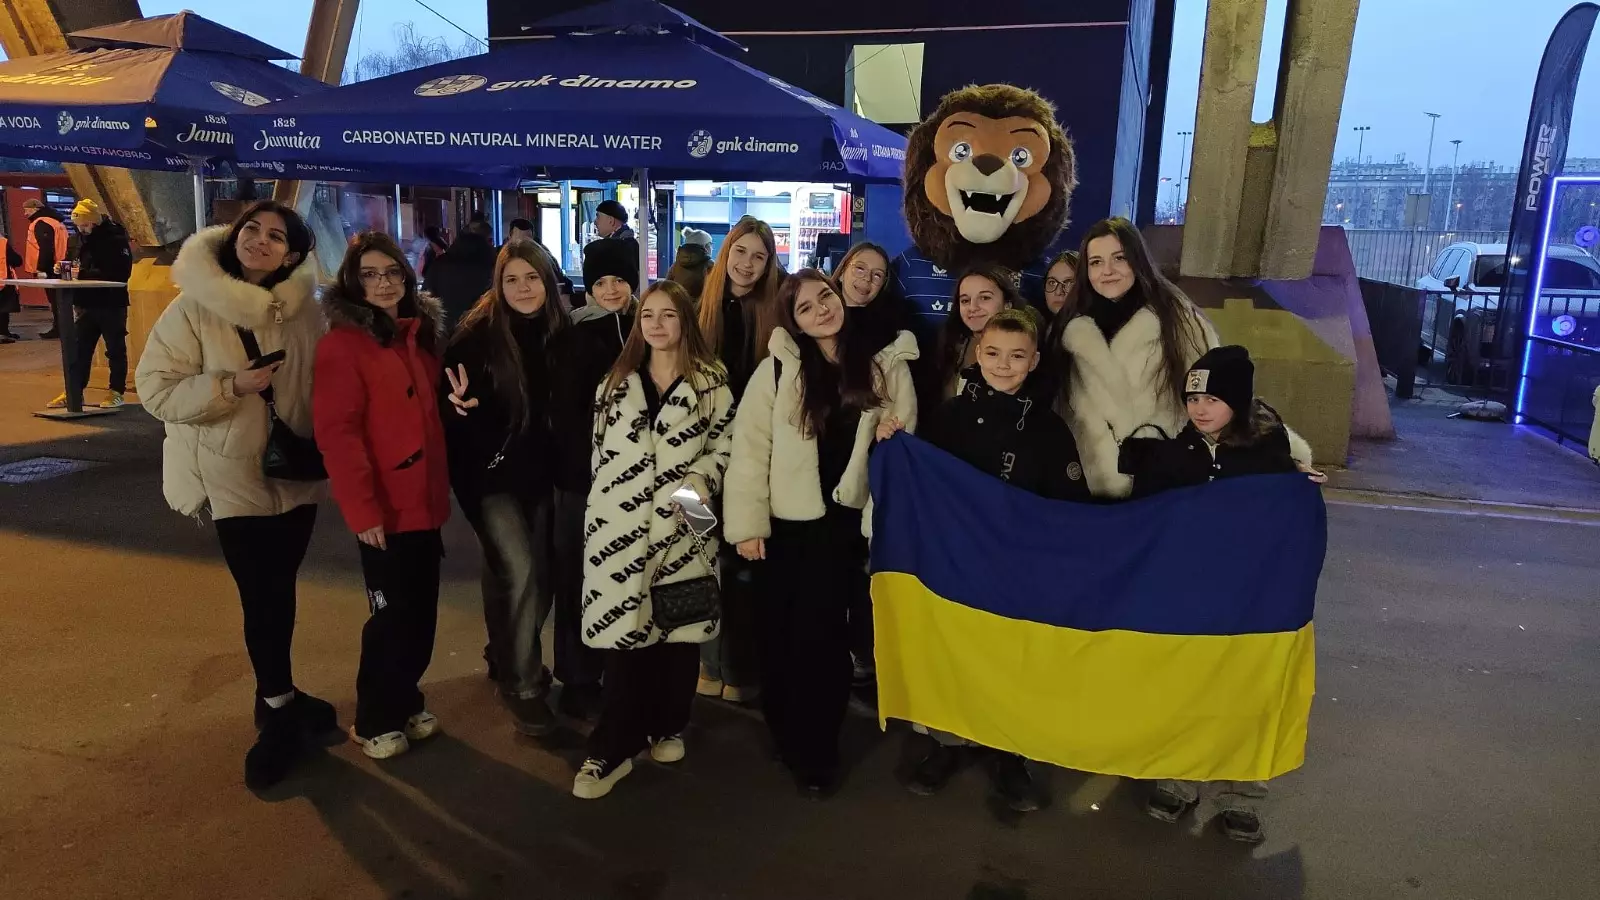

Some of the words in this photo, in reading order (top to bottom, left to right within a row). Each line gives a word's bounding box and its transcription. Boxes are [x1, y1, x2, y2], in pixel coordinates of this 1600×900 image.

[486, 75, 557, 92] gnk
[558, 75, 697, 89] dinamo
[8, 116, 42, 129] VODA
[74, 116, 91, 131] gnk
[91, 116, 130, 130] dinamo
[204, 114, 228, 125] 1828
[273, 118, 296, 128] 1828
[254, 129, 322, 151] Jamnica
[342, 130, 446, 145] CARBONATED
[450, 132, 522, 147] NATURAL
[526, 133, 599, 148] MINERAL
[603, 134, 662, 150] WATER
[716, 136, 743, 154] gnk
[745, 136, 799, 154] dinamo
[1526, 124, 1550, 211] POWER
